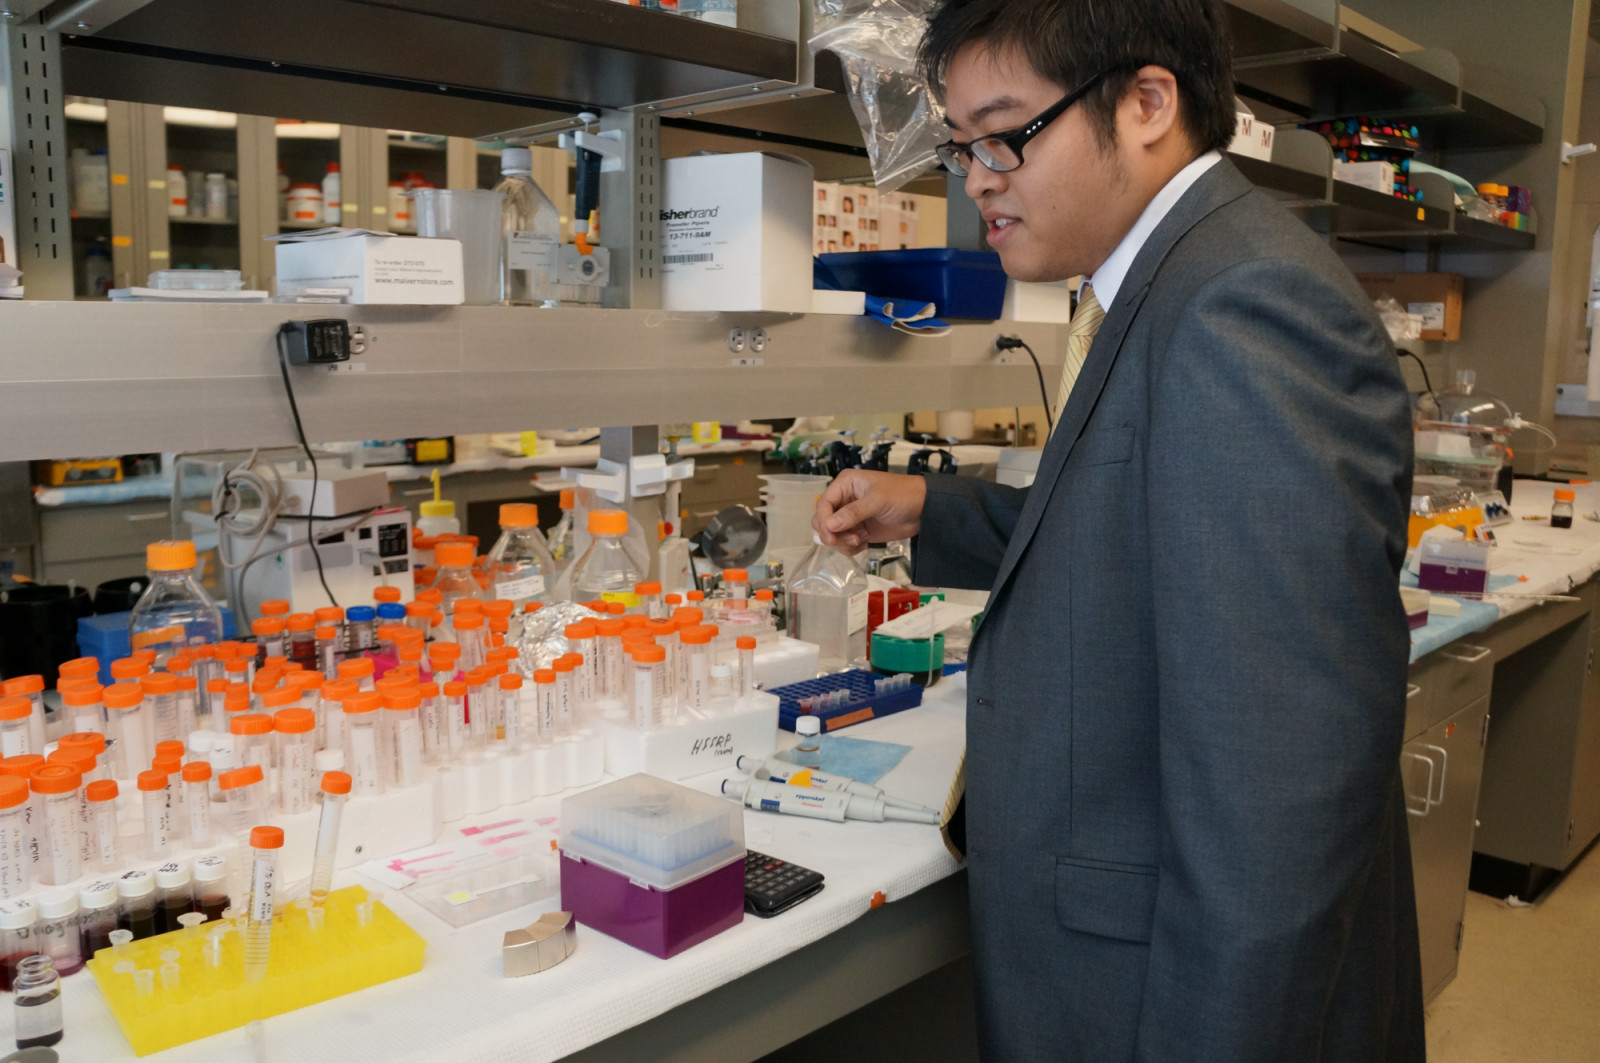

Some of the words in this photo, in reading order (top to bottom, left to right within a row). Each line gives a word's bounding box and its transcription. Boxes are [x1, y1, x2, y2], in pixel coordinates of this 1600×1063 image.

[1242, 118, 1252, 136] M
[1261, 130, 1271, 148] M
[659, 208, 718, 221] isherbrand
